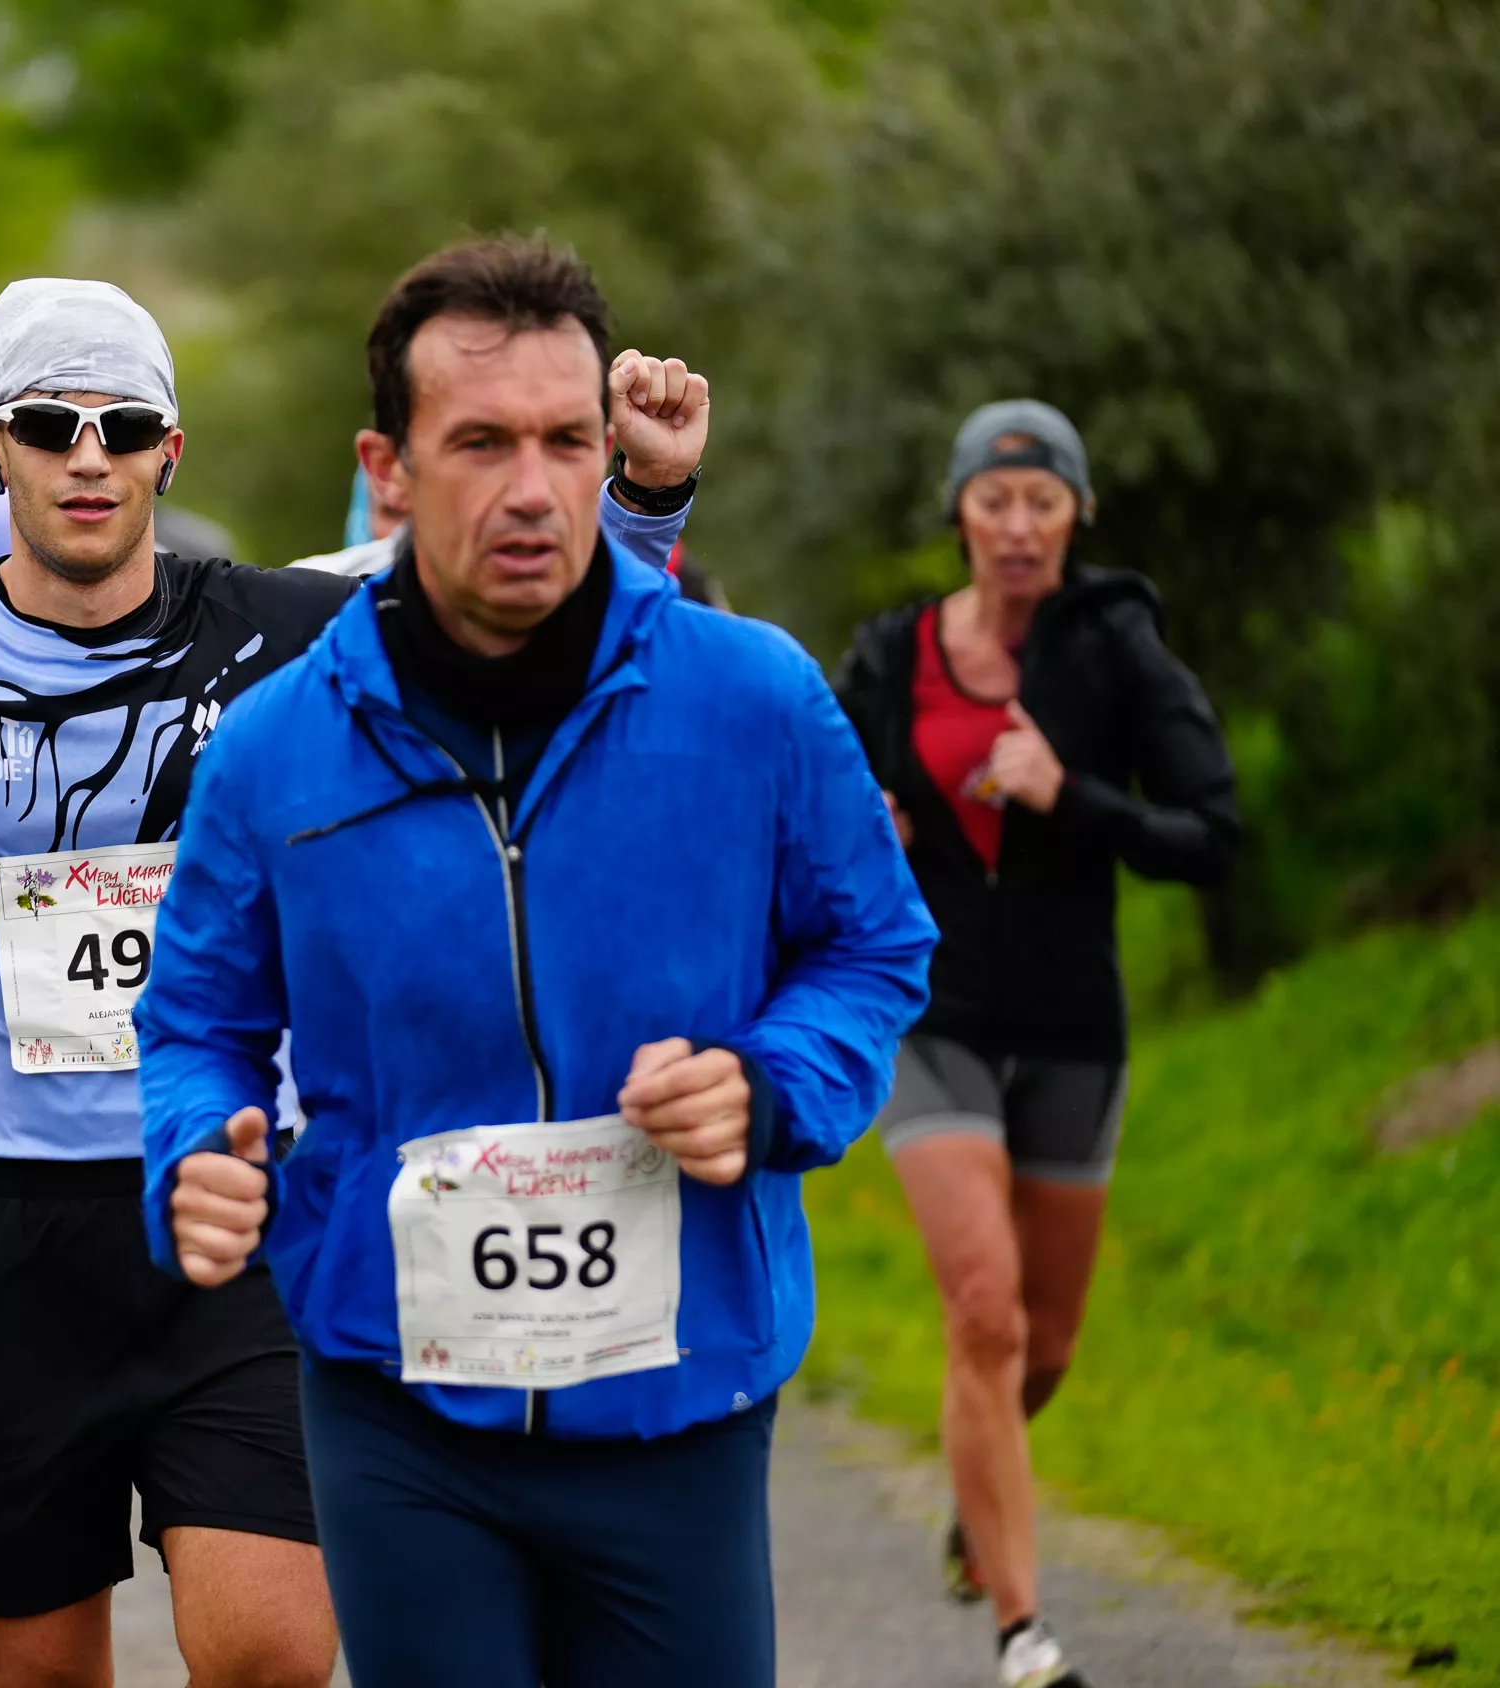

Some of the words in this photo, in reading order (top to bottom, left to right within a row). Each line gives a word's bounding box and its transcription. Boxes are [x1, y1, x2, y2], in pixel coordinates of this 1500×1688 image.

[97, 884, 168, 906] LUCENA
[67, 929, 152, 991] 49
[472, 1219, 618, 1291] 658
